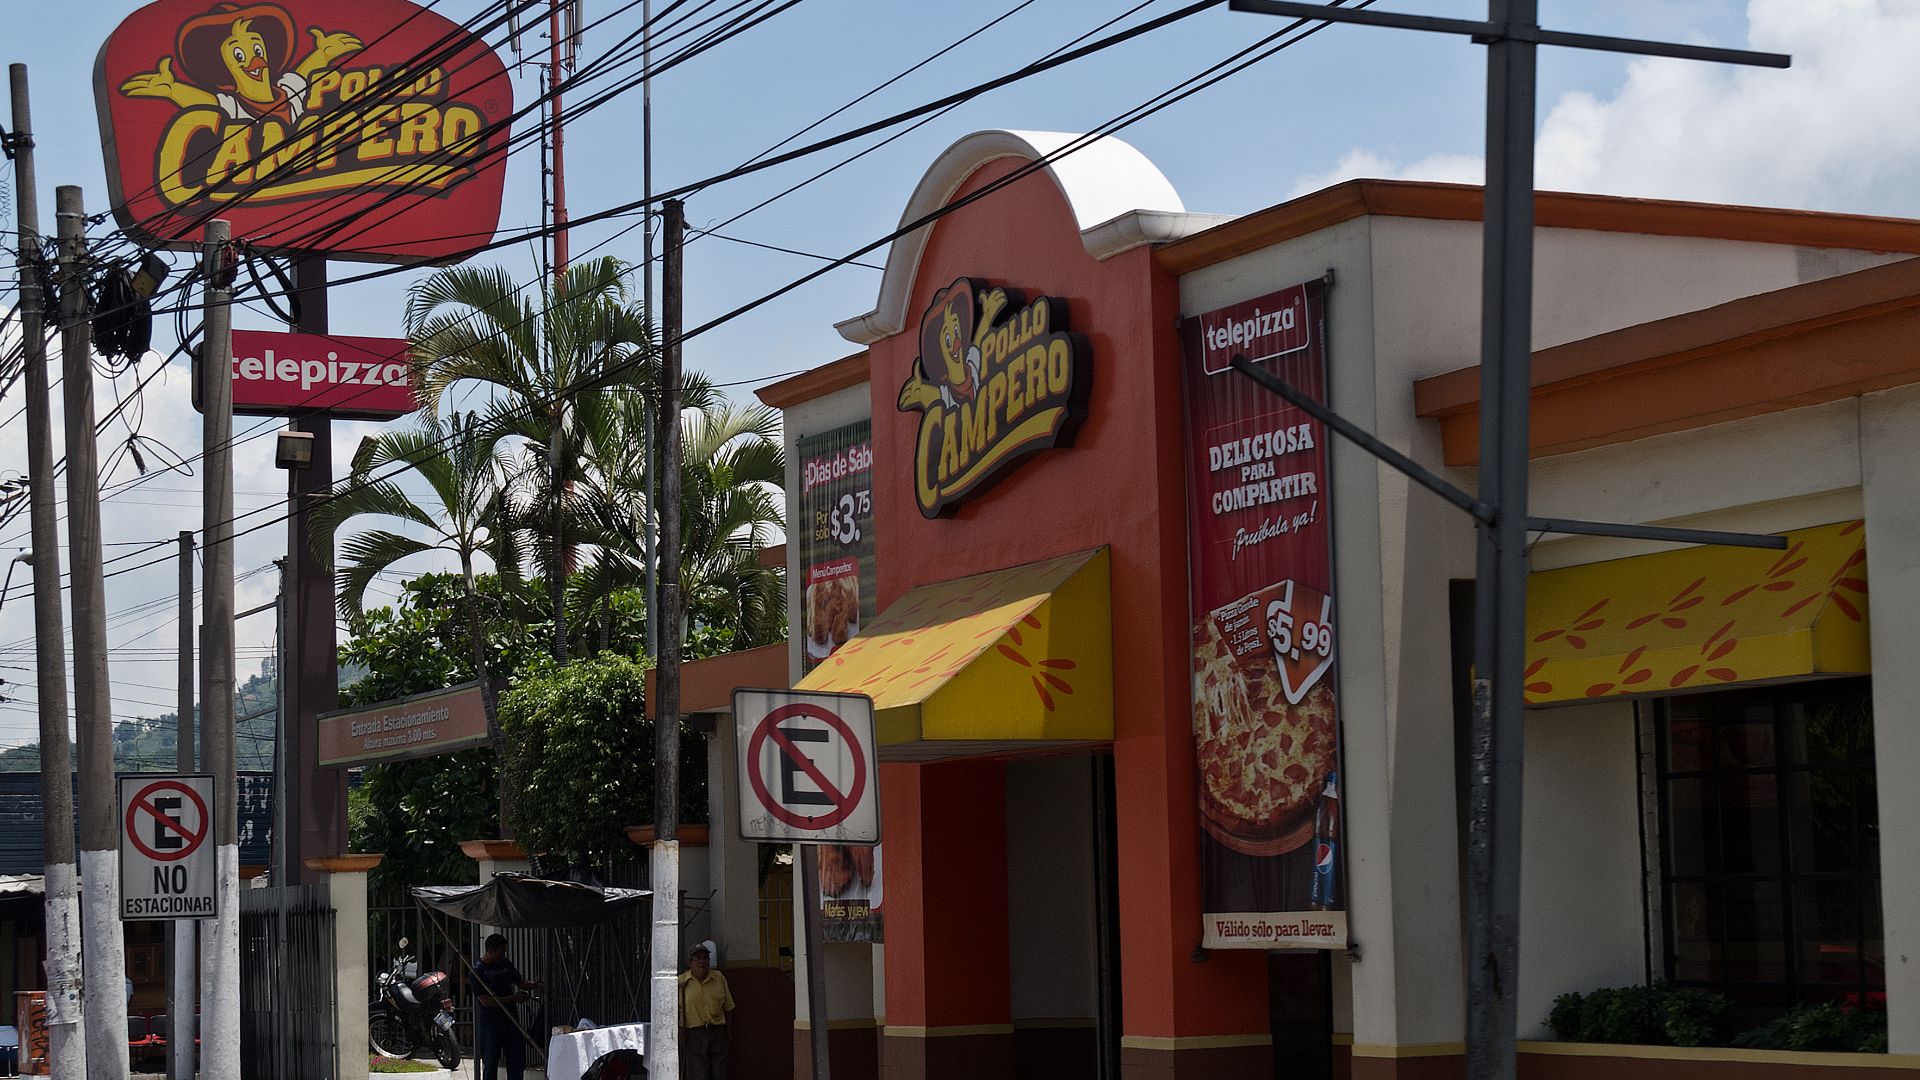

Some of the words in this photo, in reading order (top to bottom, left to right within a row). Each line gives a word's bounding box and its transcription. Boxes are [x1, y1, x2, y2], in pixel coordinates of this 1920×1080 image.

[306, 66, 443, 110] POLLO
[158, 102, 482, 206] CAMPERO
[980, 299, 1048, 379] POLLO
[1207, 307, 1295, 351] telepizza
[918, 338, 1070, 508] CAMPERO
[832, 453, 848, 479] de
[1209, 423, 1315, 472] DELICIOSA
[1241, 460, 1276, 483] PARA
[1212, 471, 1318, 515] COMPARTIR
[816, 511, 830, 526] Por
[351, 716, 382, 737] Entrada
[383, 706, 449, 732] Estacionamiento
[153, 864, 188, 895] NO
[126, 896, 213, 914] ESTACIONAR
[1216, 921, 1250, 938] Válido
[1251, 921, 1273, 938] sólo
[1274, 923, 1300, 942] para
[1301, 919, 1336, 937] llevar.
